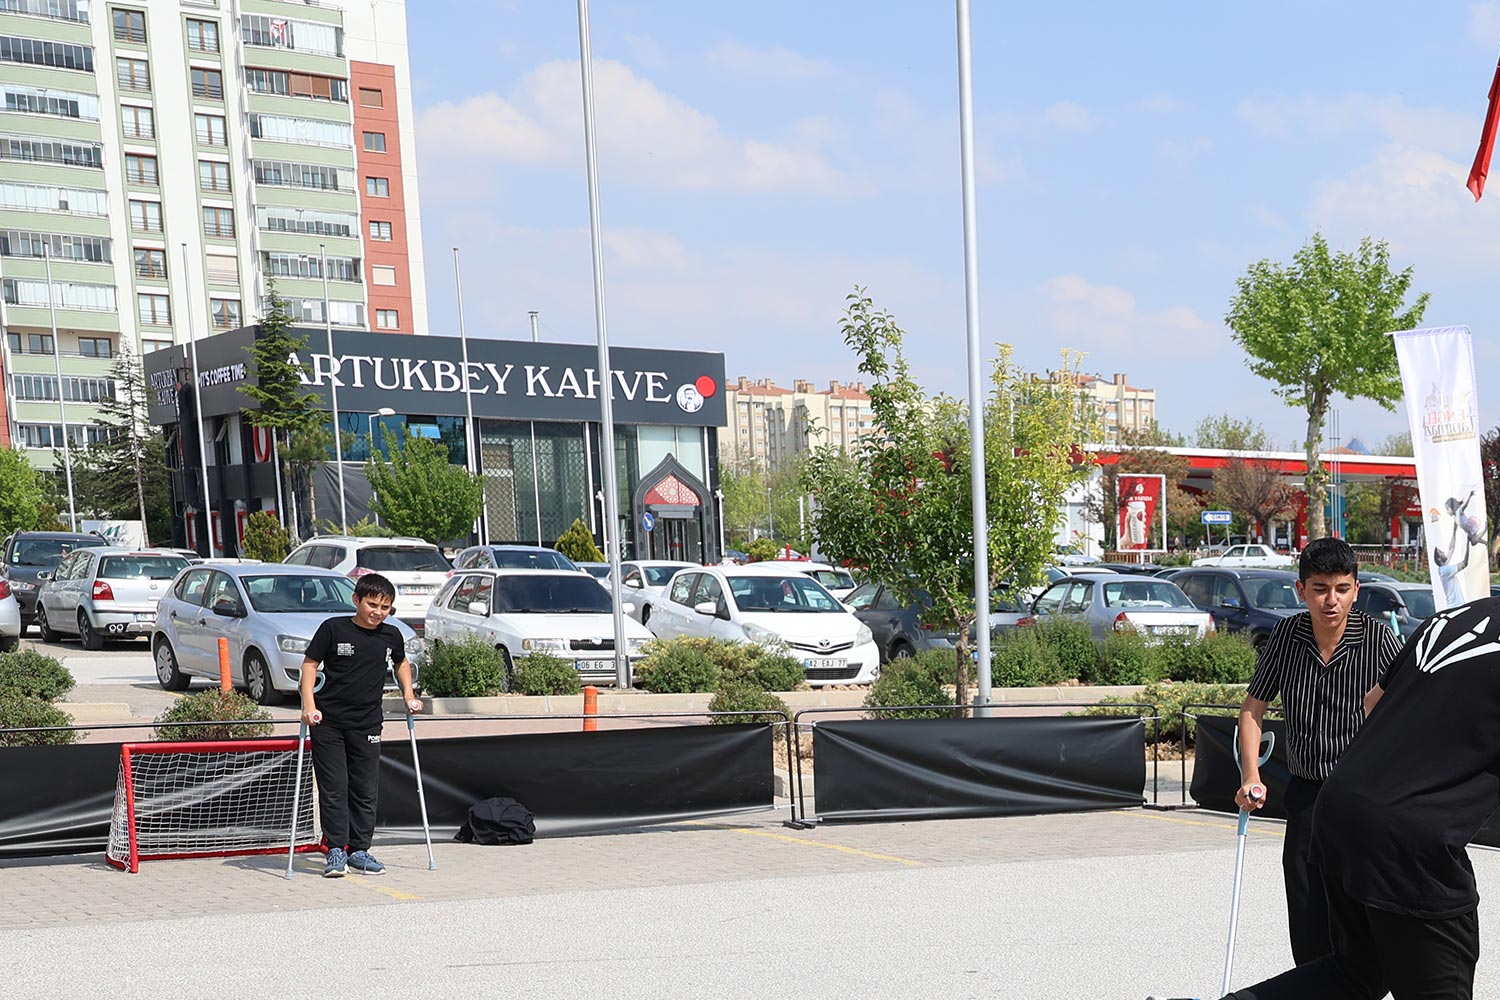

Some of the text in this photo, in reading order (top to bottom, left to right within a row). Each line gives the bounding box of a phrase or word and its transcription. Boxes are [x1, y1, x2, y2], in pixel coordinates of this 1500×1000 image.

[210, 366, 230, 385] COFFEE
[231, 363, 244, 381] TIME
[282, 352, 672, 403] ARTUKBEY KAHVE
[594, 661, 604, 669] EG
